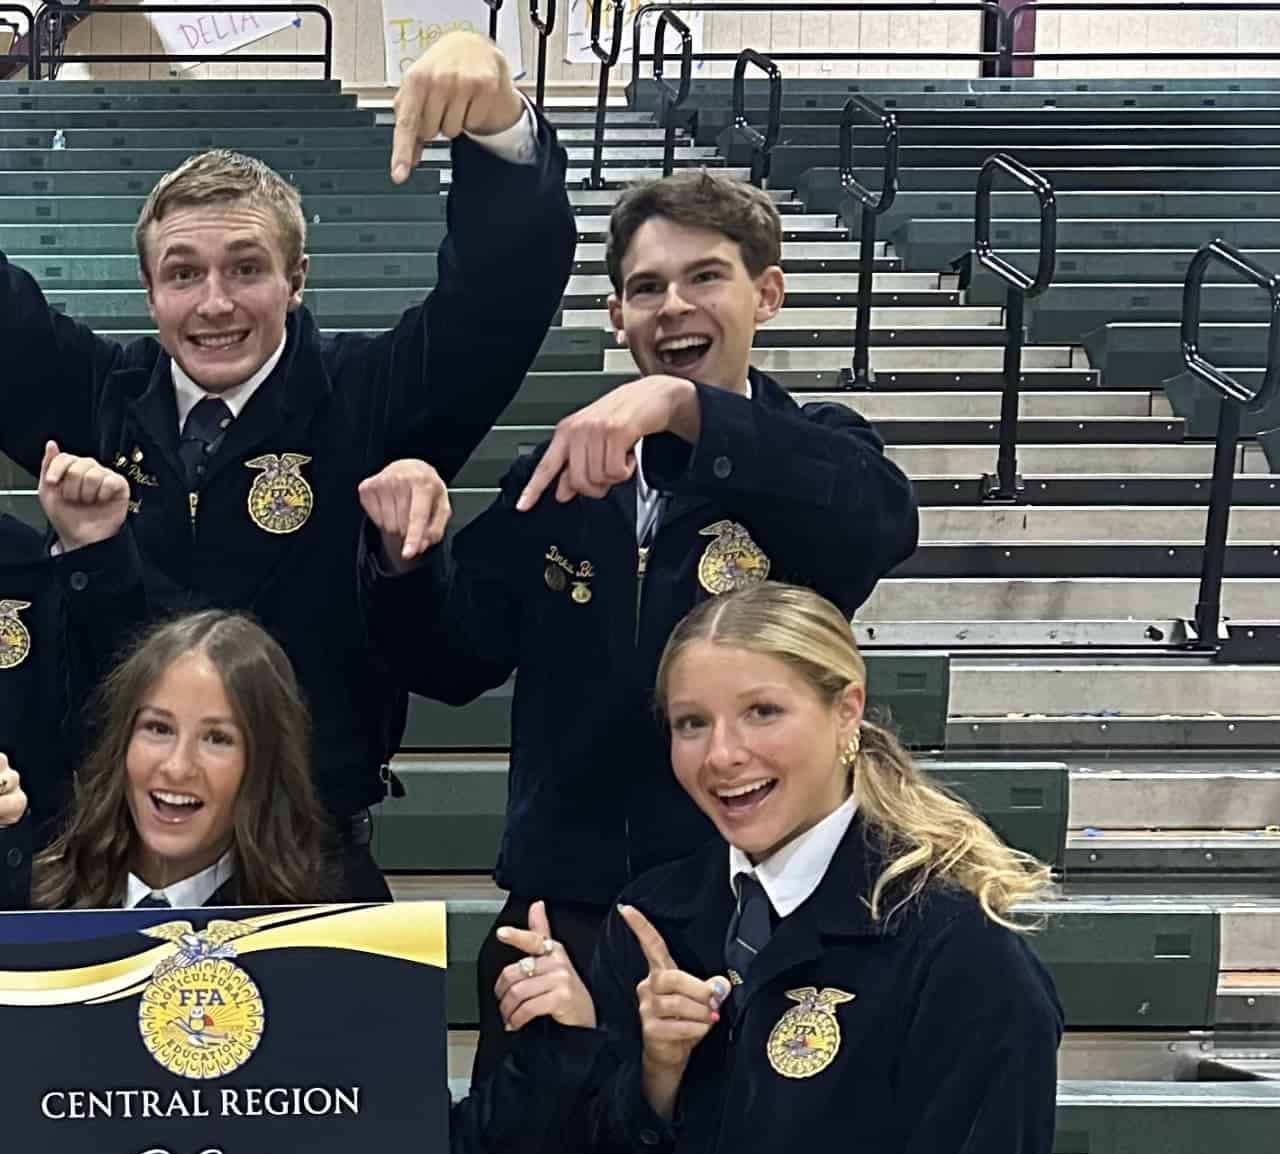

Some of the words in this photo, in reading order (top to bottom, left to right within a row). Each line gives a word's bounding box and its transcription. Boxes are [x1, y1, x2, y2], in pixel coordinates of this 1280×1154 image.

[179, 988, 226, 1006] FFA
[166, 1036, 239, 1062] EDUCATION
[41, 1089, 209, 1119] CENTRAL
[221, 1087, 360, 1116] REGION
